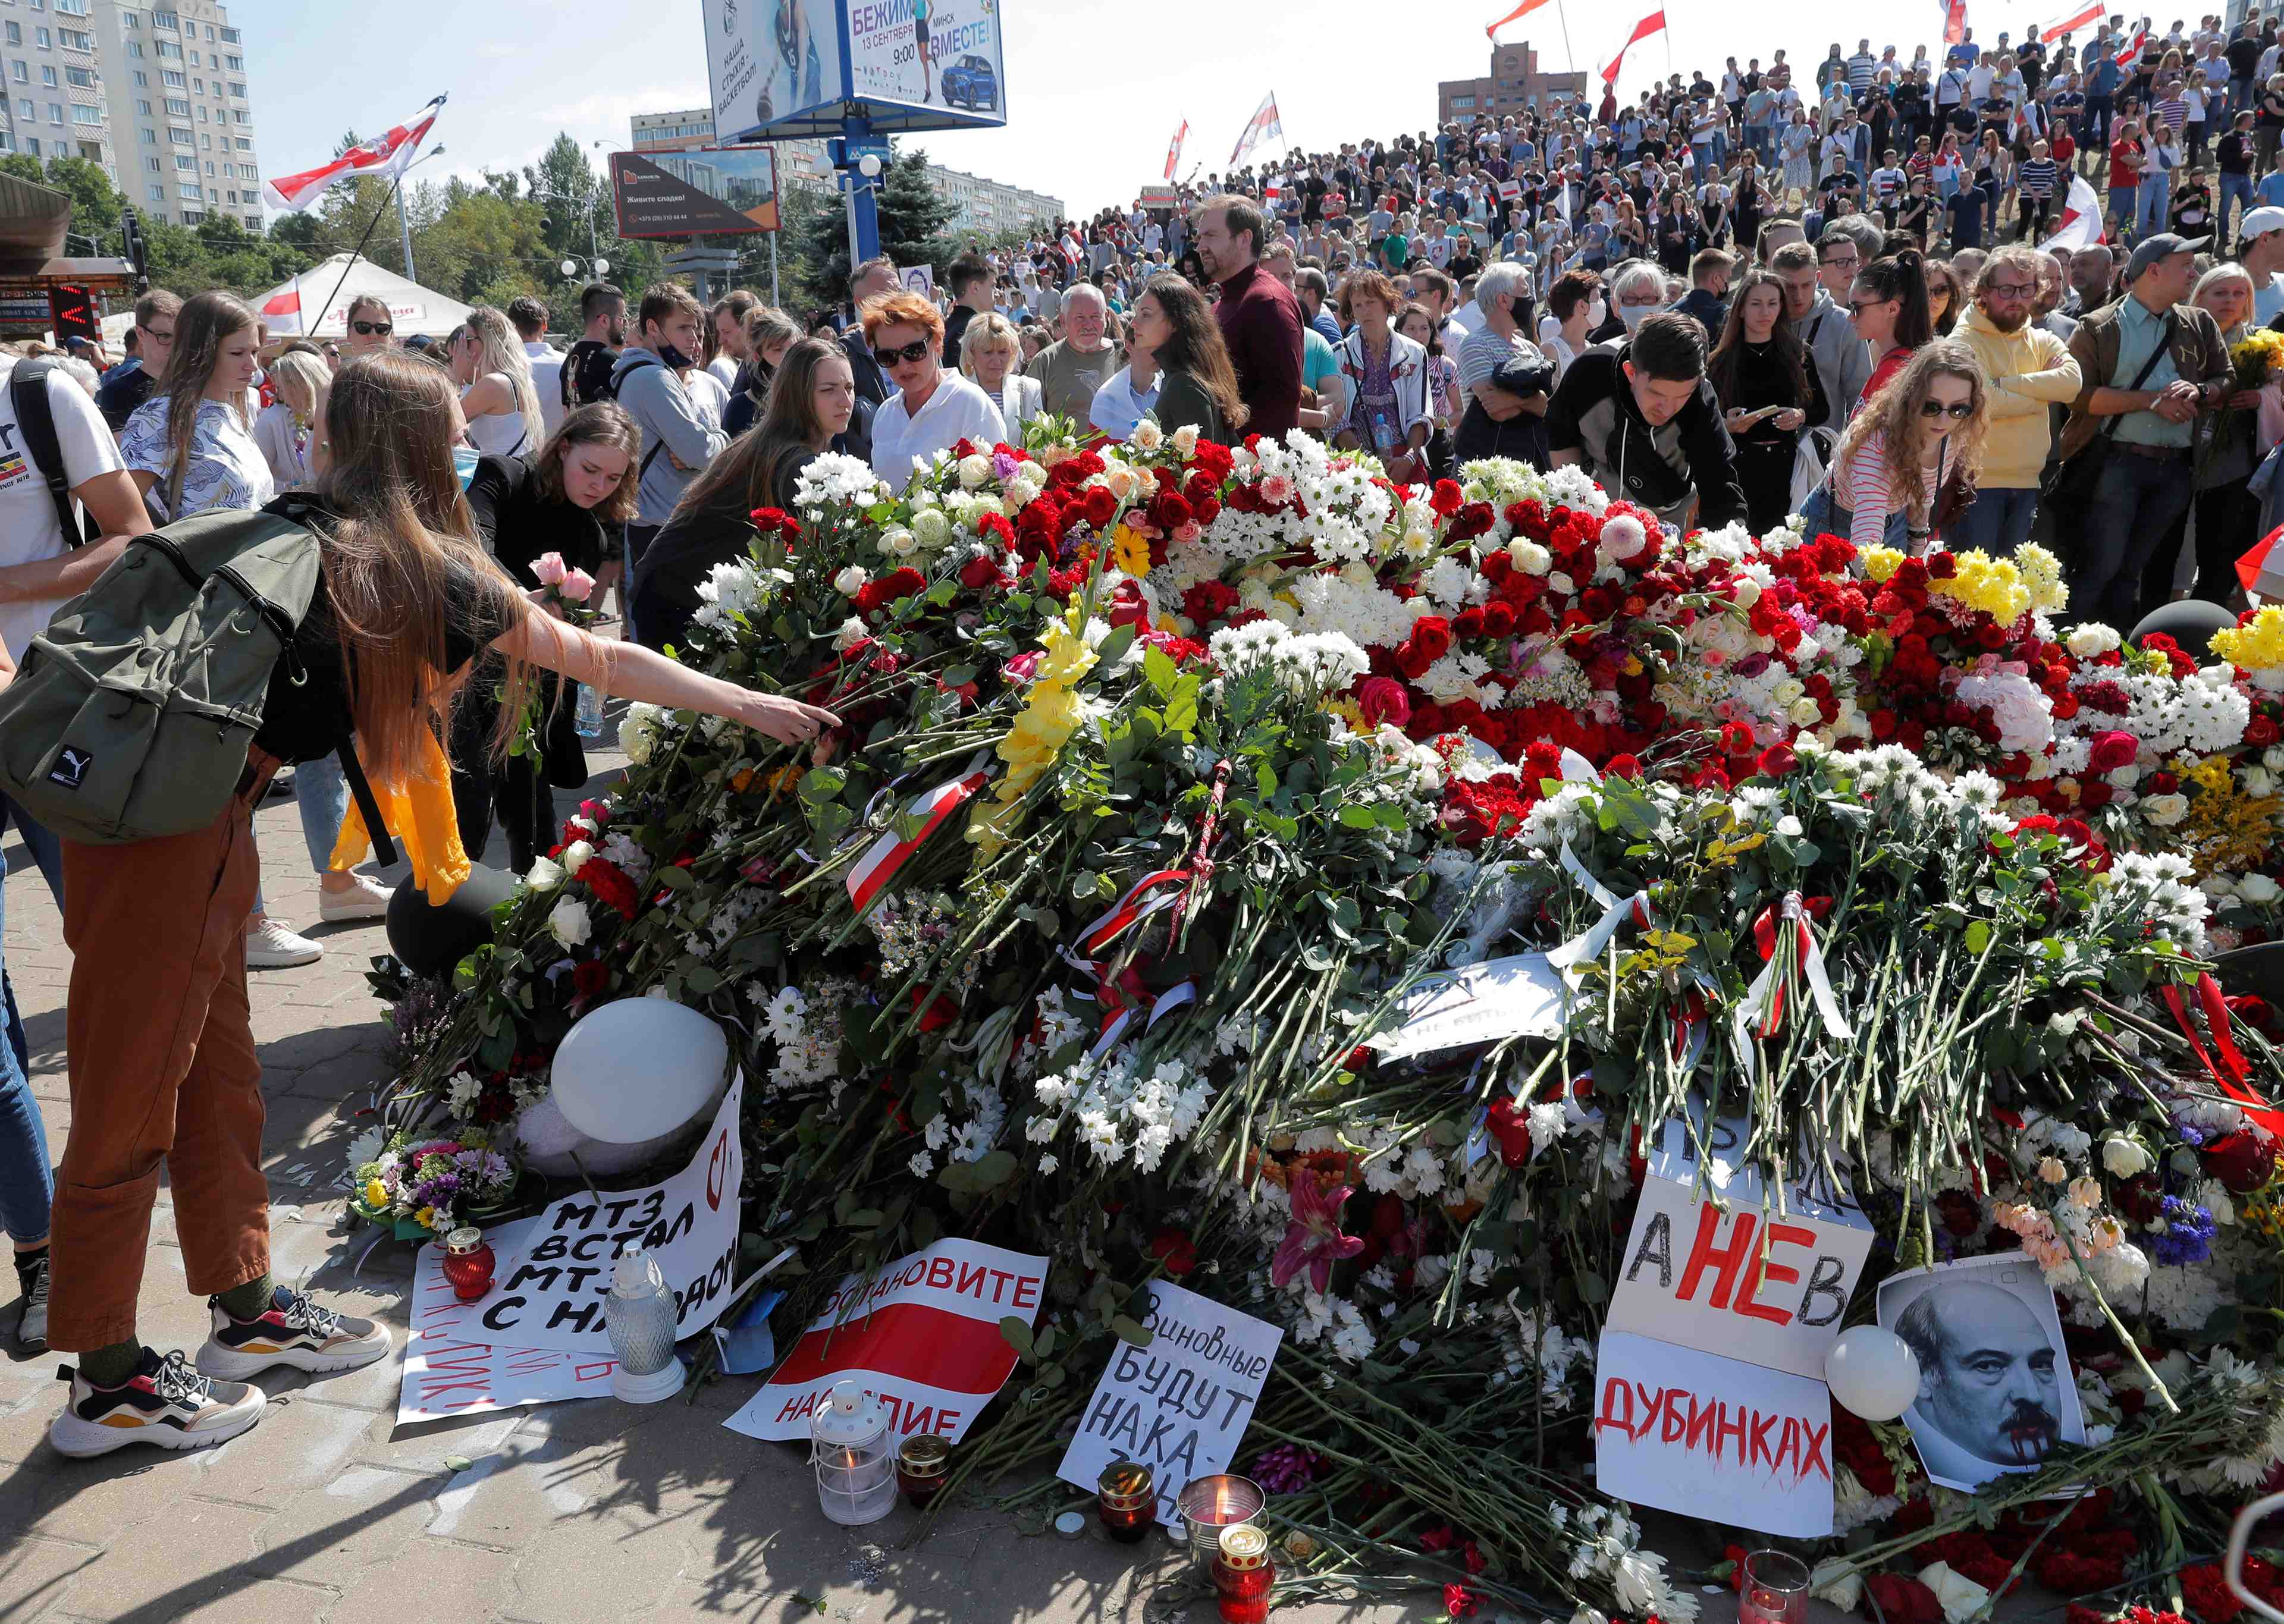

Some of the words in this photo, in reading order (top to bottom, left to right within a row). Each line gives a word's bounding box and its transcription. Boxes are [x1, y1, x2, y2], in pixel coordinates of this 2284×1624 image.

[853, 0, 912, 36] БЕЖИМ
[933, 12, 955, 29] МИНСК
[724, 38, 744, 70] НАША
[862, 38, 871, 51] 13
[873, 24, 914, 48] СЕНТЯБРЯ
[894, 44, 914, 65] 9:00
[931, 19, 990, 58] ВМЕСТЕ!
[719, 62, 757, 115] БАСКЕТБОЛ!
[552, 1189, 666, 1232] МТЗ
[1626, 1212, 1672, 1289] А
[1675, 1201, 1817, 1327] НЕ
[1797, 1254, 1848, 1327] В
[482, 1296, 527, 1330] С
[1114, 1345, 1254, 1431] БУДУТ
[1595, 1377, 1831, 1483] ДУБИНКАХ
